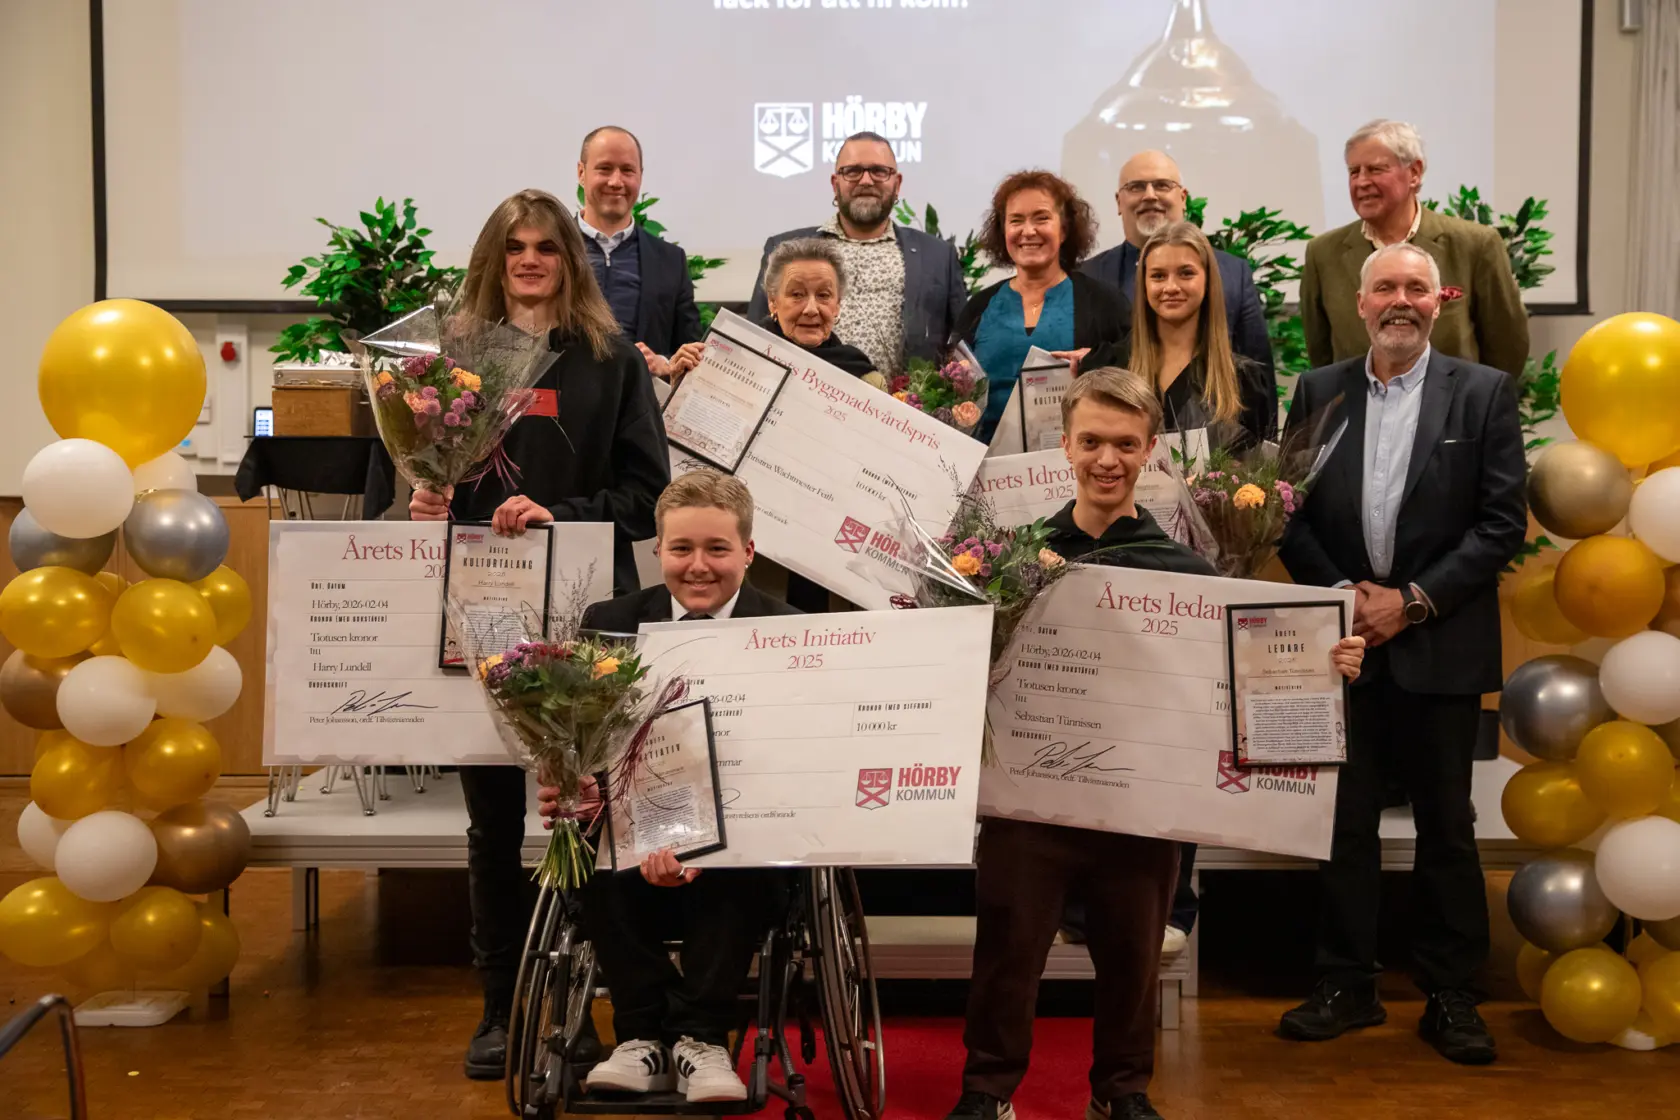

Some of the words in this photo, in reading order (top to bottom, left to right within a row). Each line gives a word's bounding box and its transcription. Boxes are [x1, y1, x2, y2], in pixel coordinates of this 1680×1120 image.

[822, 95, 928, 139] HÖRBY
[822, 140, 922, 163] KUN
[702, 356, 773, 396] YGGNADSVÅRDSPRISET
[801, 368, 940, 450] Byggnadsvårdspris
[1034, 395, 1065, 405] KULTUR
[824, 405, 848, 422] 2025
[1027, 464, 1077, 486] Idrot
[1043, 484, 1074, 501] 2025
[341, 534, 404, 561] Årets
[409, 538, 447, 561] Kul
[870, 531, 902, 559] HÖR
[424, 564, 448, 578] 202
[463, 557, 533, 570] KULTURTALANG
[312, 599, 341, 611] Hörby,
[341, 599, 389, 609] 2026-02-04
[1095, 582, 1162, 614] Årets
[1167, 592, 1226, 620] ledar
[1140, 617, 1179, 636] 2025
[1274, 629, 1297, 637] ÅRETS
[310, 632, 347, 642] Tiotusen
[349, 632, 379, 642] kronor
[744, 628, 797, 650] Årets
[803, 626, 876, 647] Initiativ
[1021, 643, 1051, 658] Hörby,
[1051, 646, 1102, 661] 2026-02-04
[1267, 643, 1305, 654] LEDARE
[313, 662, 338, 674] Harry
[340, 662, 372, 672] Lundell
[787, 653, 823, 670] 2025
[1016, 678, 1055, 692] Tiotusen
[1056, 682, 1087, 696] kronor
[887, 720, 898, 731] kr
[1014, 710, 1055, 724] Sebastian
[1056, 714, 1102, 729] Tünnissen
[897, 762, 962, 788] HÖRBY
[896, 788, 956, 801] KOMMUN
[1255, 776, 1317, 796] KOMMUN
